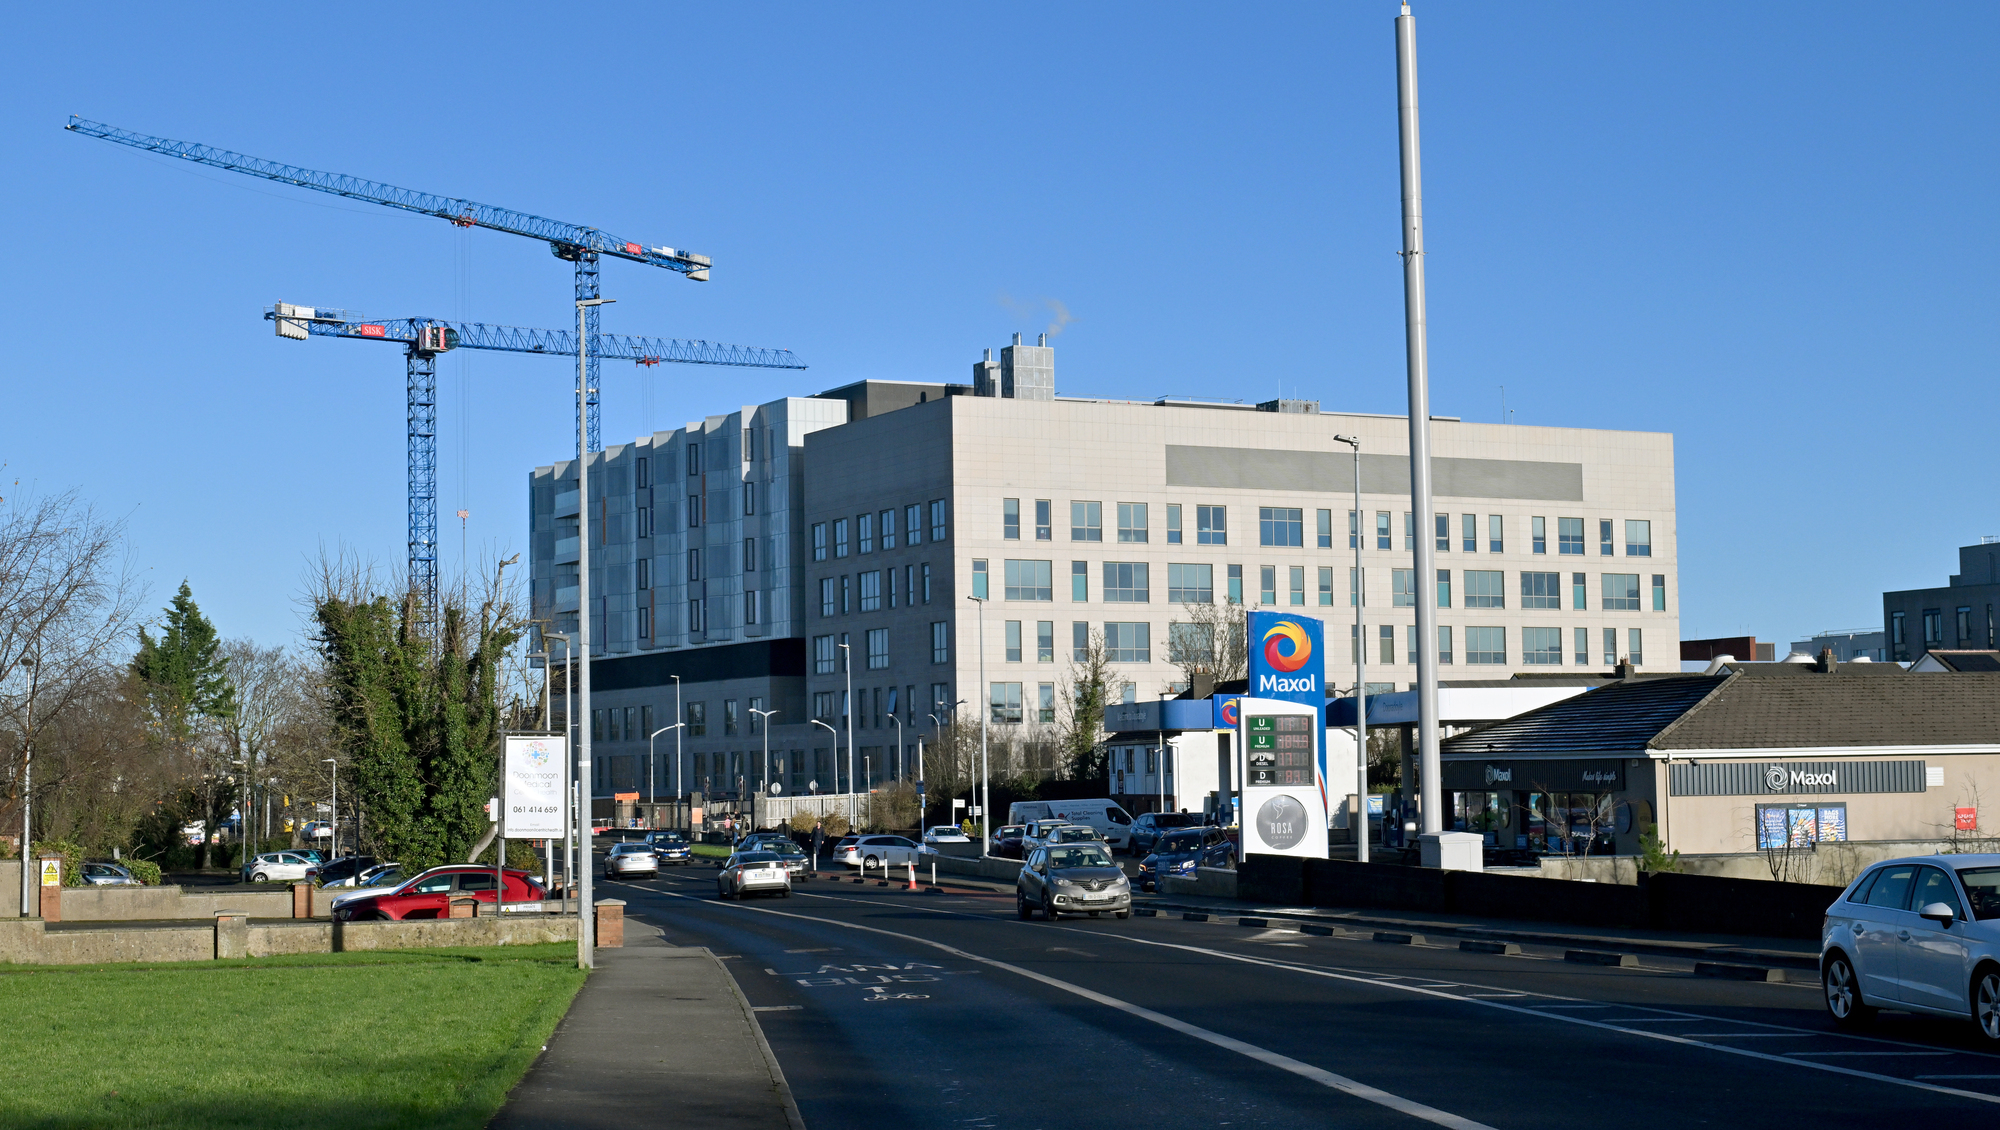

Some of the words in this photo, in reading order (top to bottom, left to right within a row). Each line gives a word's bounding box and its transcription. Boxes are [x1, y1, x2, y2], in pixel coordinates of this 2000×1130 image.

[628, 243, 640, 253] SISK
[364, 325, 382, 335] SISK
[1259, 673, 1316, 693] Maxol
[1258, 718, 1265, 727] U
[1258, 736, 1265, 744] U
[1259, 754, 1265, 762] D
[1259, 771, 1266, 779] D
[1493, 768, 1512, 782] Maxol
[1789, 769, 1837, 786] Maxol
[523, 780, 552, 788] edical
[513, 805, 526, 813] 061
[529, 805, 543, 813] 414
[544, 805, 558, 813] 659
[1270, 822, 1293, 834] ROSA
[796, 973, 943, 987] BUS
